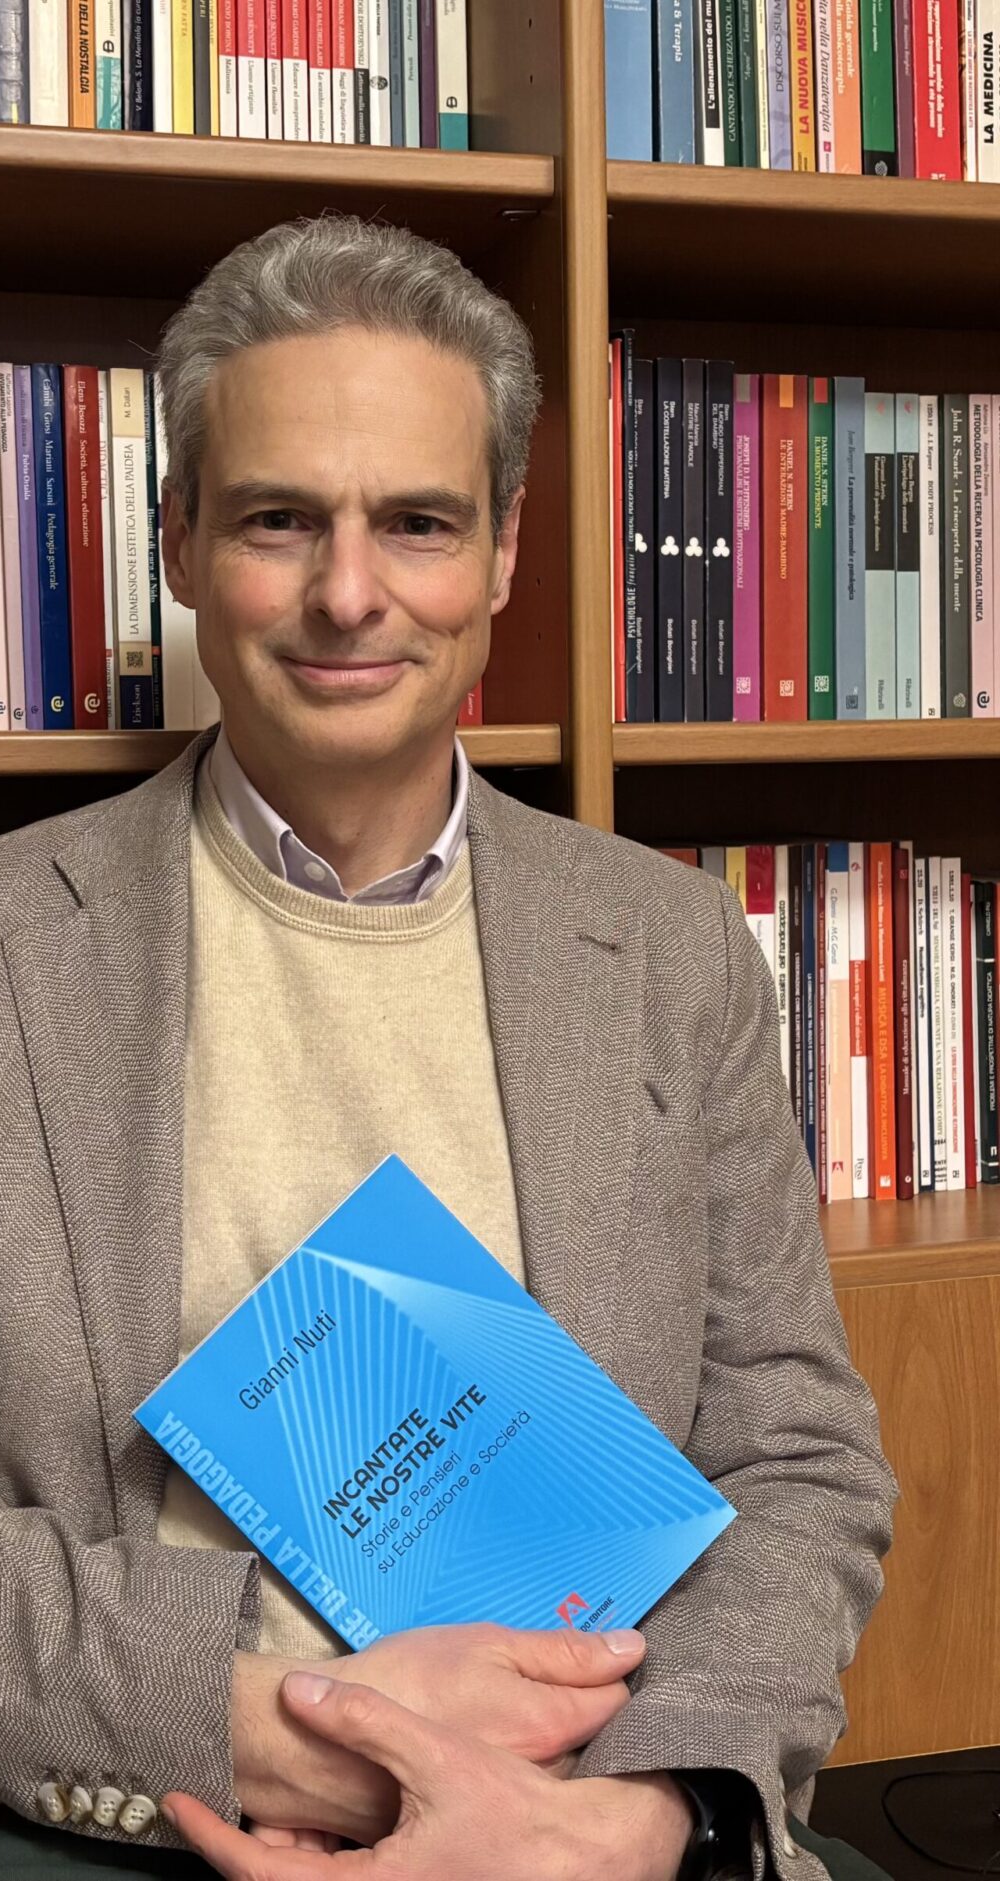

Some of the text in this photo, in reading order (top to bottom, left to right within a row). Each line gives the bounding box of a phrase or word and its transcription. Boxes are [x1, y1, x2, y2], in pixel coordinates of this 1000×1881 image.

[78, 3, 89, 93] DELLA NOSTALGIA
[704, 19, 715, 108] L'allenamento del
[774, 33, 784, 91] DISCORSO
[797, 56, 809, 133] LA NUOVA
[819, 17, 831, 132] nella Danzaterapia
[983, 31, 994, 143] LA MEDICINA
[45, 513, 57, 589] Pedagogia generale
[122, 444, 139, 634] LA DIMENSIONE ESTETICA DELLA PAIDEIA
[973, 404, 984, 621] METODOLOGIA DELLA RICERCA IN PSICOLOGIA CLINICA
[239, 1310, 335, 1409] Gianni Nuti
[155, 1411, 282, 1550] PEDAGOGIA
[321, 1407, 429, 1520] INCANTATE
[341, 1384, 485, 1538] LE NOSTRE VITE
[361, 1450, 461, 1557] Storie e Pensieri
[378, 1411, 529, 1573] su Educazione e Società
[273, 1536, 348, 1616] DELLA
[588, 1596, 615, 1624] EDITORE
